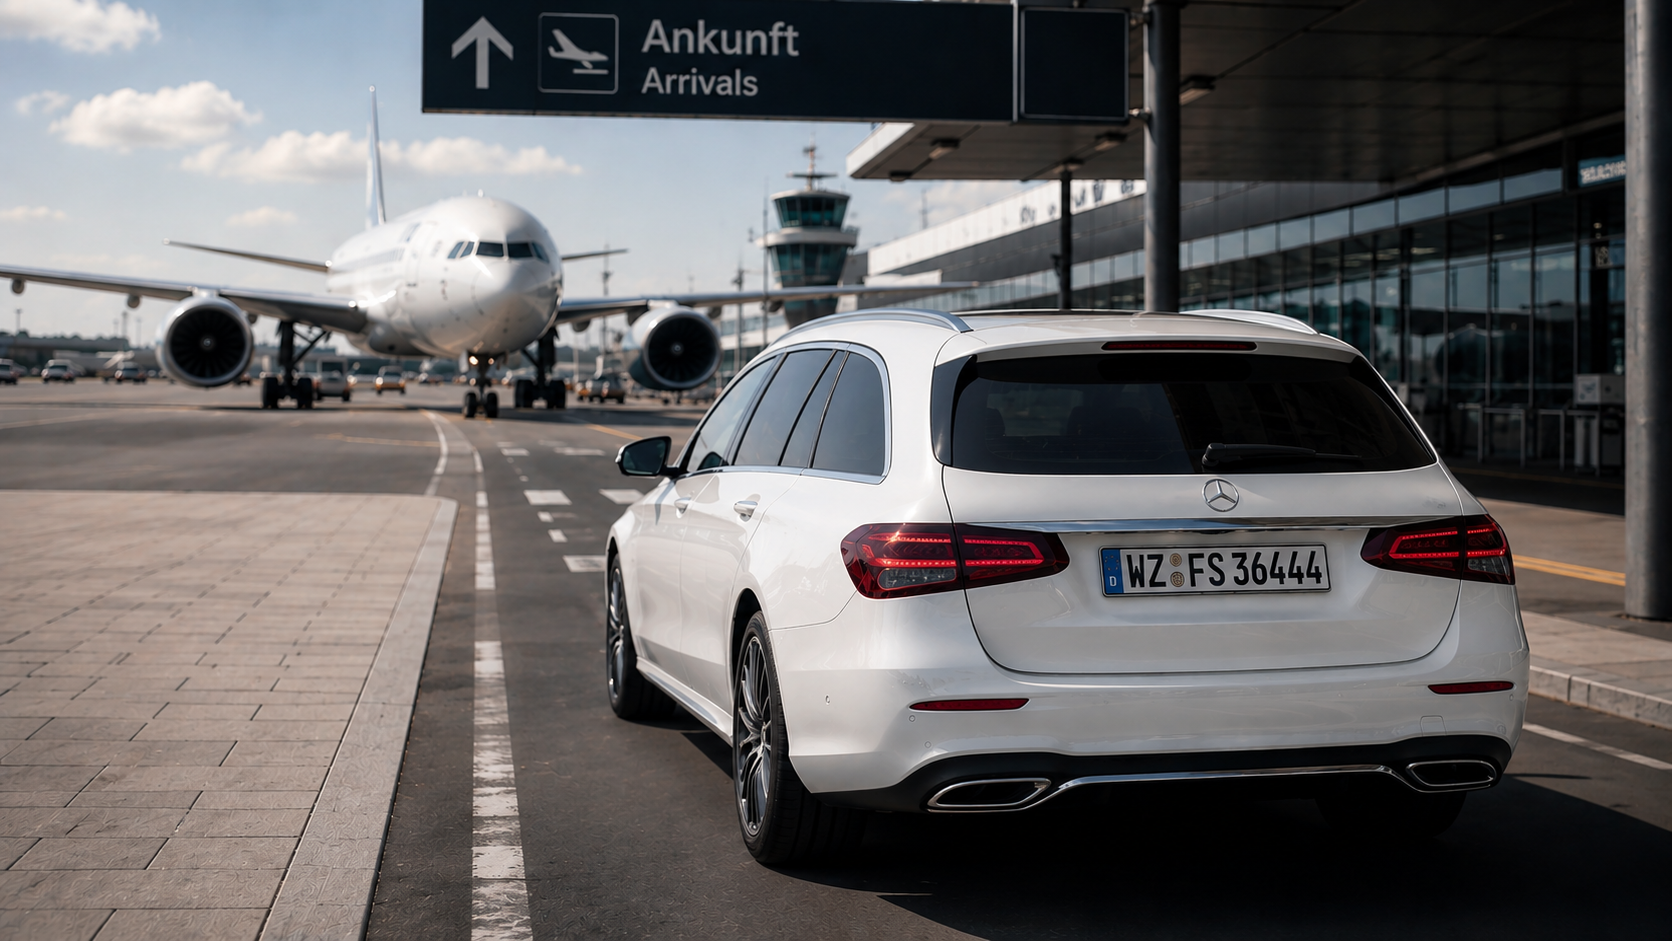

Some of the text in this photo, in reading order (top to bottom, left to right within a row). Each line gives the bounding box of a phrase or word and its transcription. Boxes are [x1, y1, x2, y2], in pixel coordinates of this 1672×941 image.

[641, 19, 799, 57] Ankunft
[641, 67, 759, 96] Arrivals
[1109, 576, 1117, 587] D
[1126, 551, 1323, 588] WZ FS 36444
